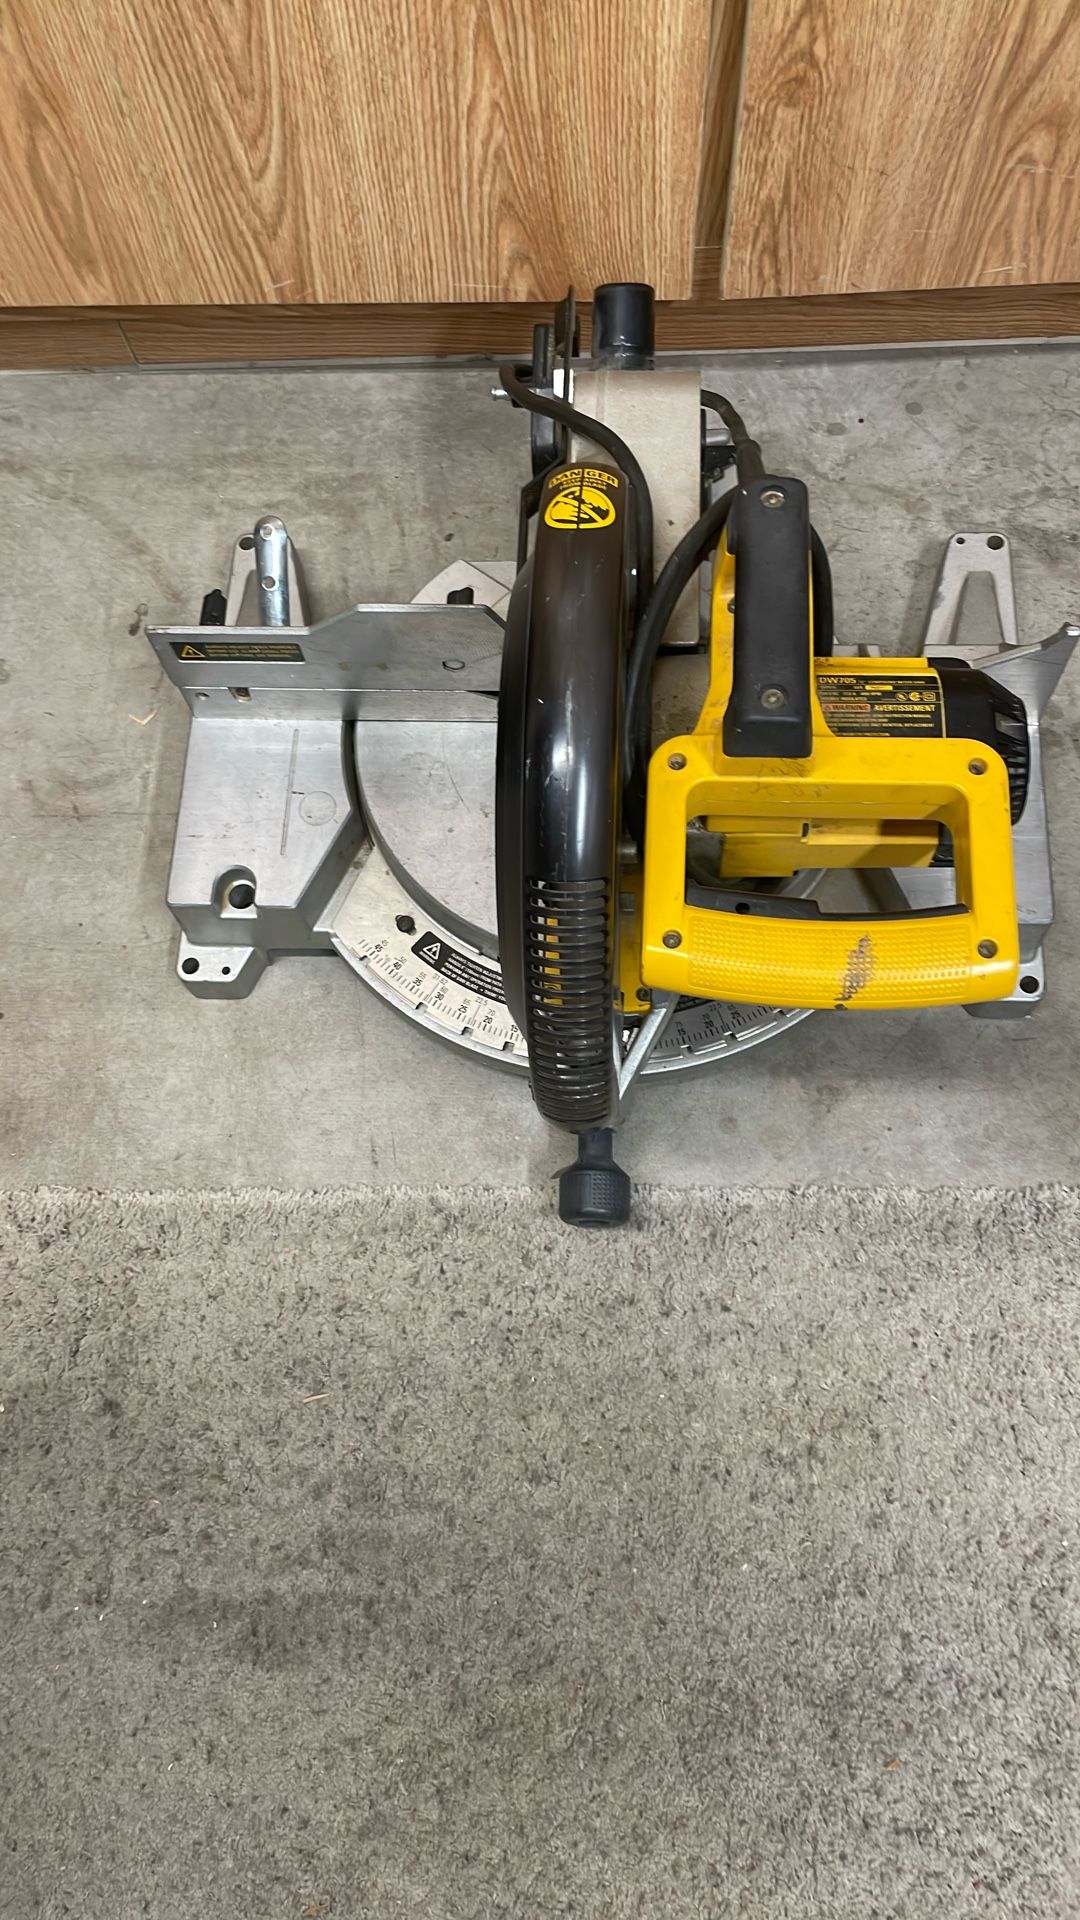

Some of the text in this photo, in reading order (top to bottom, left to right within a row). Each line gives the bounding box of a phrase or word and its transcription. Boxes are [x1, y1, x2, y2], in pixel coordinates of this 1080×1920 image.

[550, 470, 618, 486] DANGER
[874, 704, 935, 712] AVERTISSEMENT
[374, 944, 384, 953] 45
[393, 961, 403, 971] 40
[412, 977, 423, 987] 35
[434, 991, 445, 1001] 30
[458, 1004, 469, 1014] 25
[483, 1015, 493, 1025] 20
[730, 1010, 741, 1020] 25
[511, 1024, 519, 1033] 15
[704, 1019, 714, 1029] 20
[677, 1028, 687, 1036] 15
